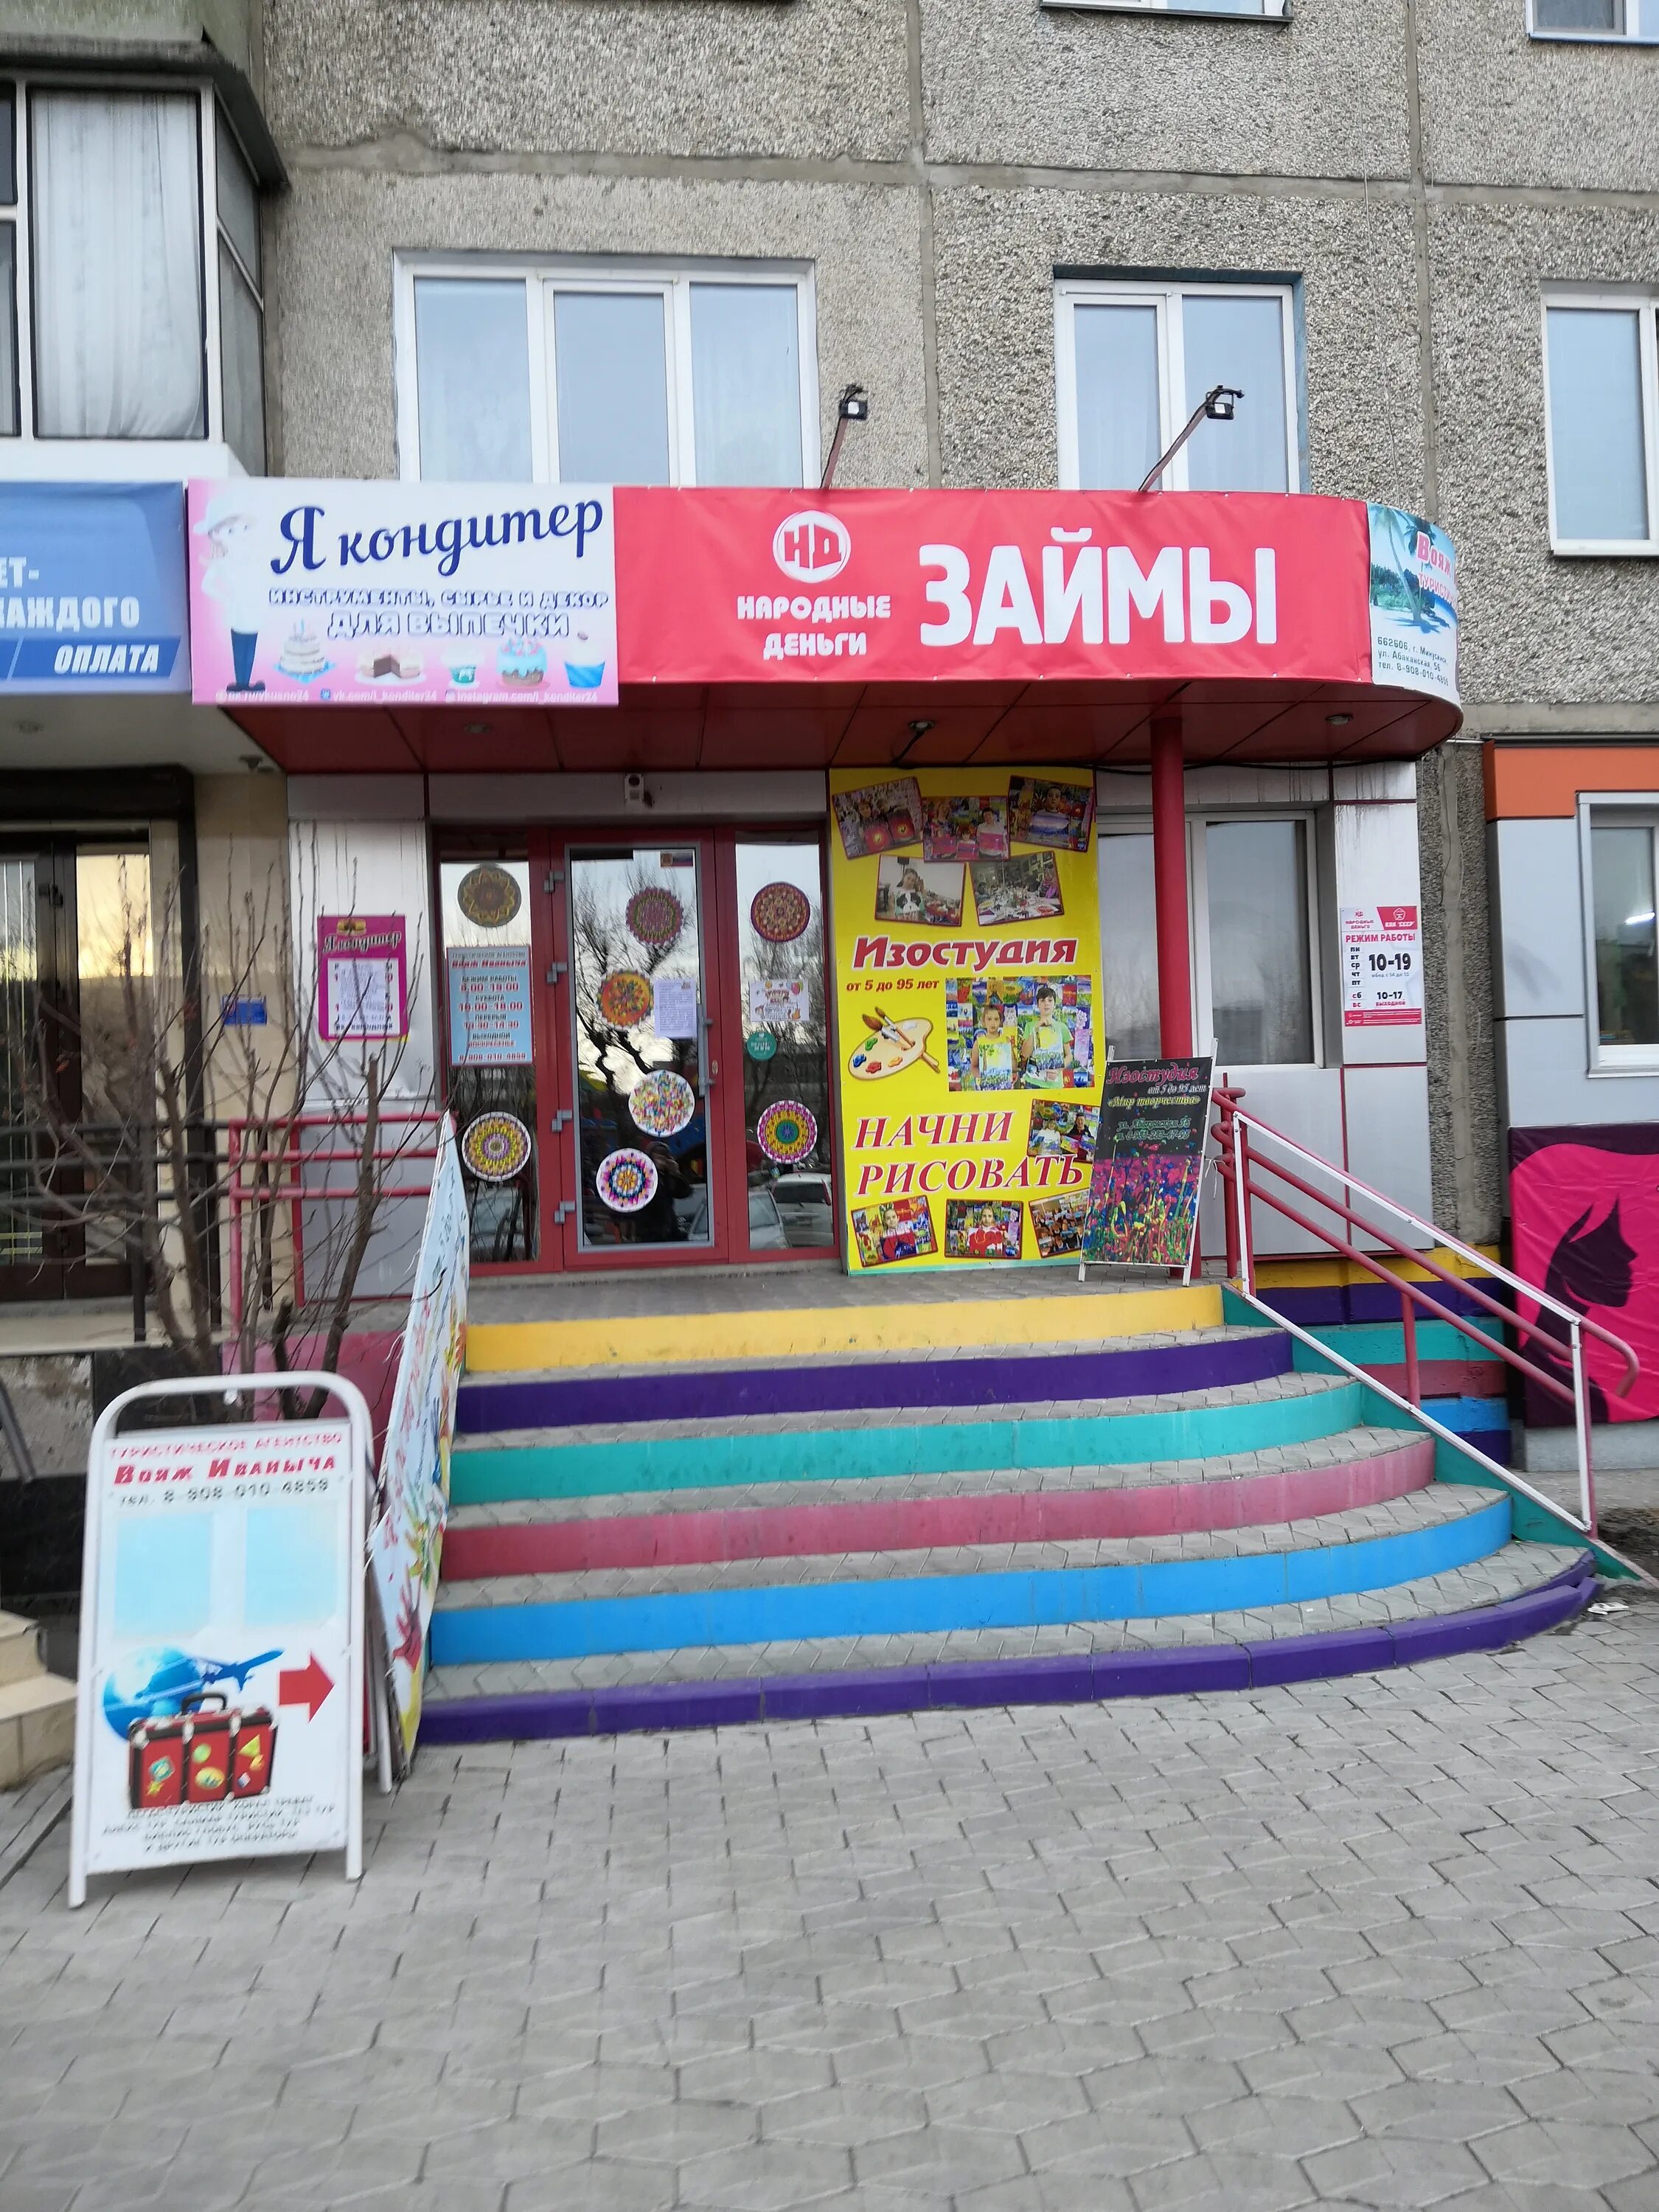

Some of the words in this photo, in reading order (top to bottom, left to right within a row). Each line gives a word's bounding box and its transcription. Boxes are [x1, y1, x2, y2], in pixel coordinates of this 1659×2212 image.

[270, 506, 327, 575] Я
[338, 498, 604, 577] кондитер
[518, 590, 535, 608] И
[539, 590, 610, 610] ДЕКОР
[919, 526, 1278, 647] ЗАЙМЫ
[327, 609, 401, 639] ДЛЯ
[406, 610, 571, 639] ВЫПЕЧКИ
[737, 595, 892, 624] НАРОДНЫЕ
[54, 644, 159, 675] ОПЛАТА
[762, 632, 868, 661] ДЕНЬГИ
[1378, 661, 1394, 670] тел.
[1346, 933, 1379, 943] РЕЖИМ
[1380, 933, 1416, 942] РАБОТЫ
[852, 936, 1079, 972] Изостудия
[1368, 953, 1412, 971] 10-19
[846, 982, 861, 992] от
[864, 978, 874, 991] 5
[876, 981, 894, 992] до
[897, 978, 914, 990] 95
[917, 979, 940, 990] лет
[1106, 1062, 1199, 1086] Изостудия
[852, 1111, 1016, 1150] НАЧНИ
[854, 1154, 1084, 1196] РИСОВАТЬ
